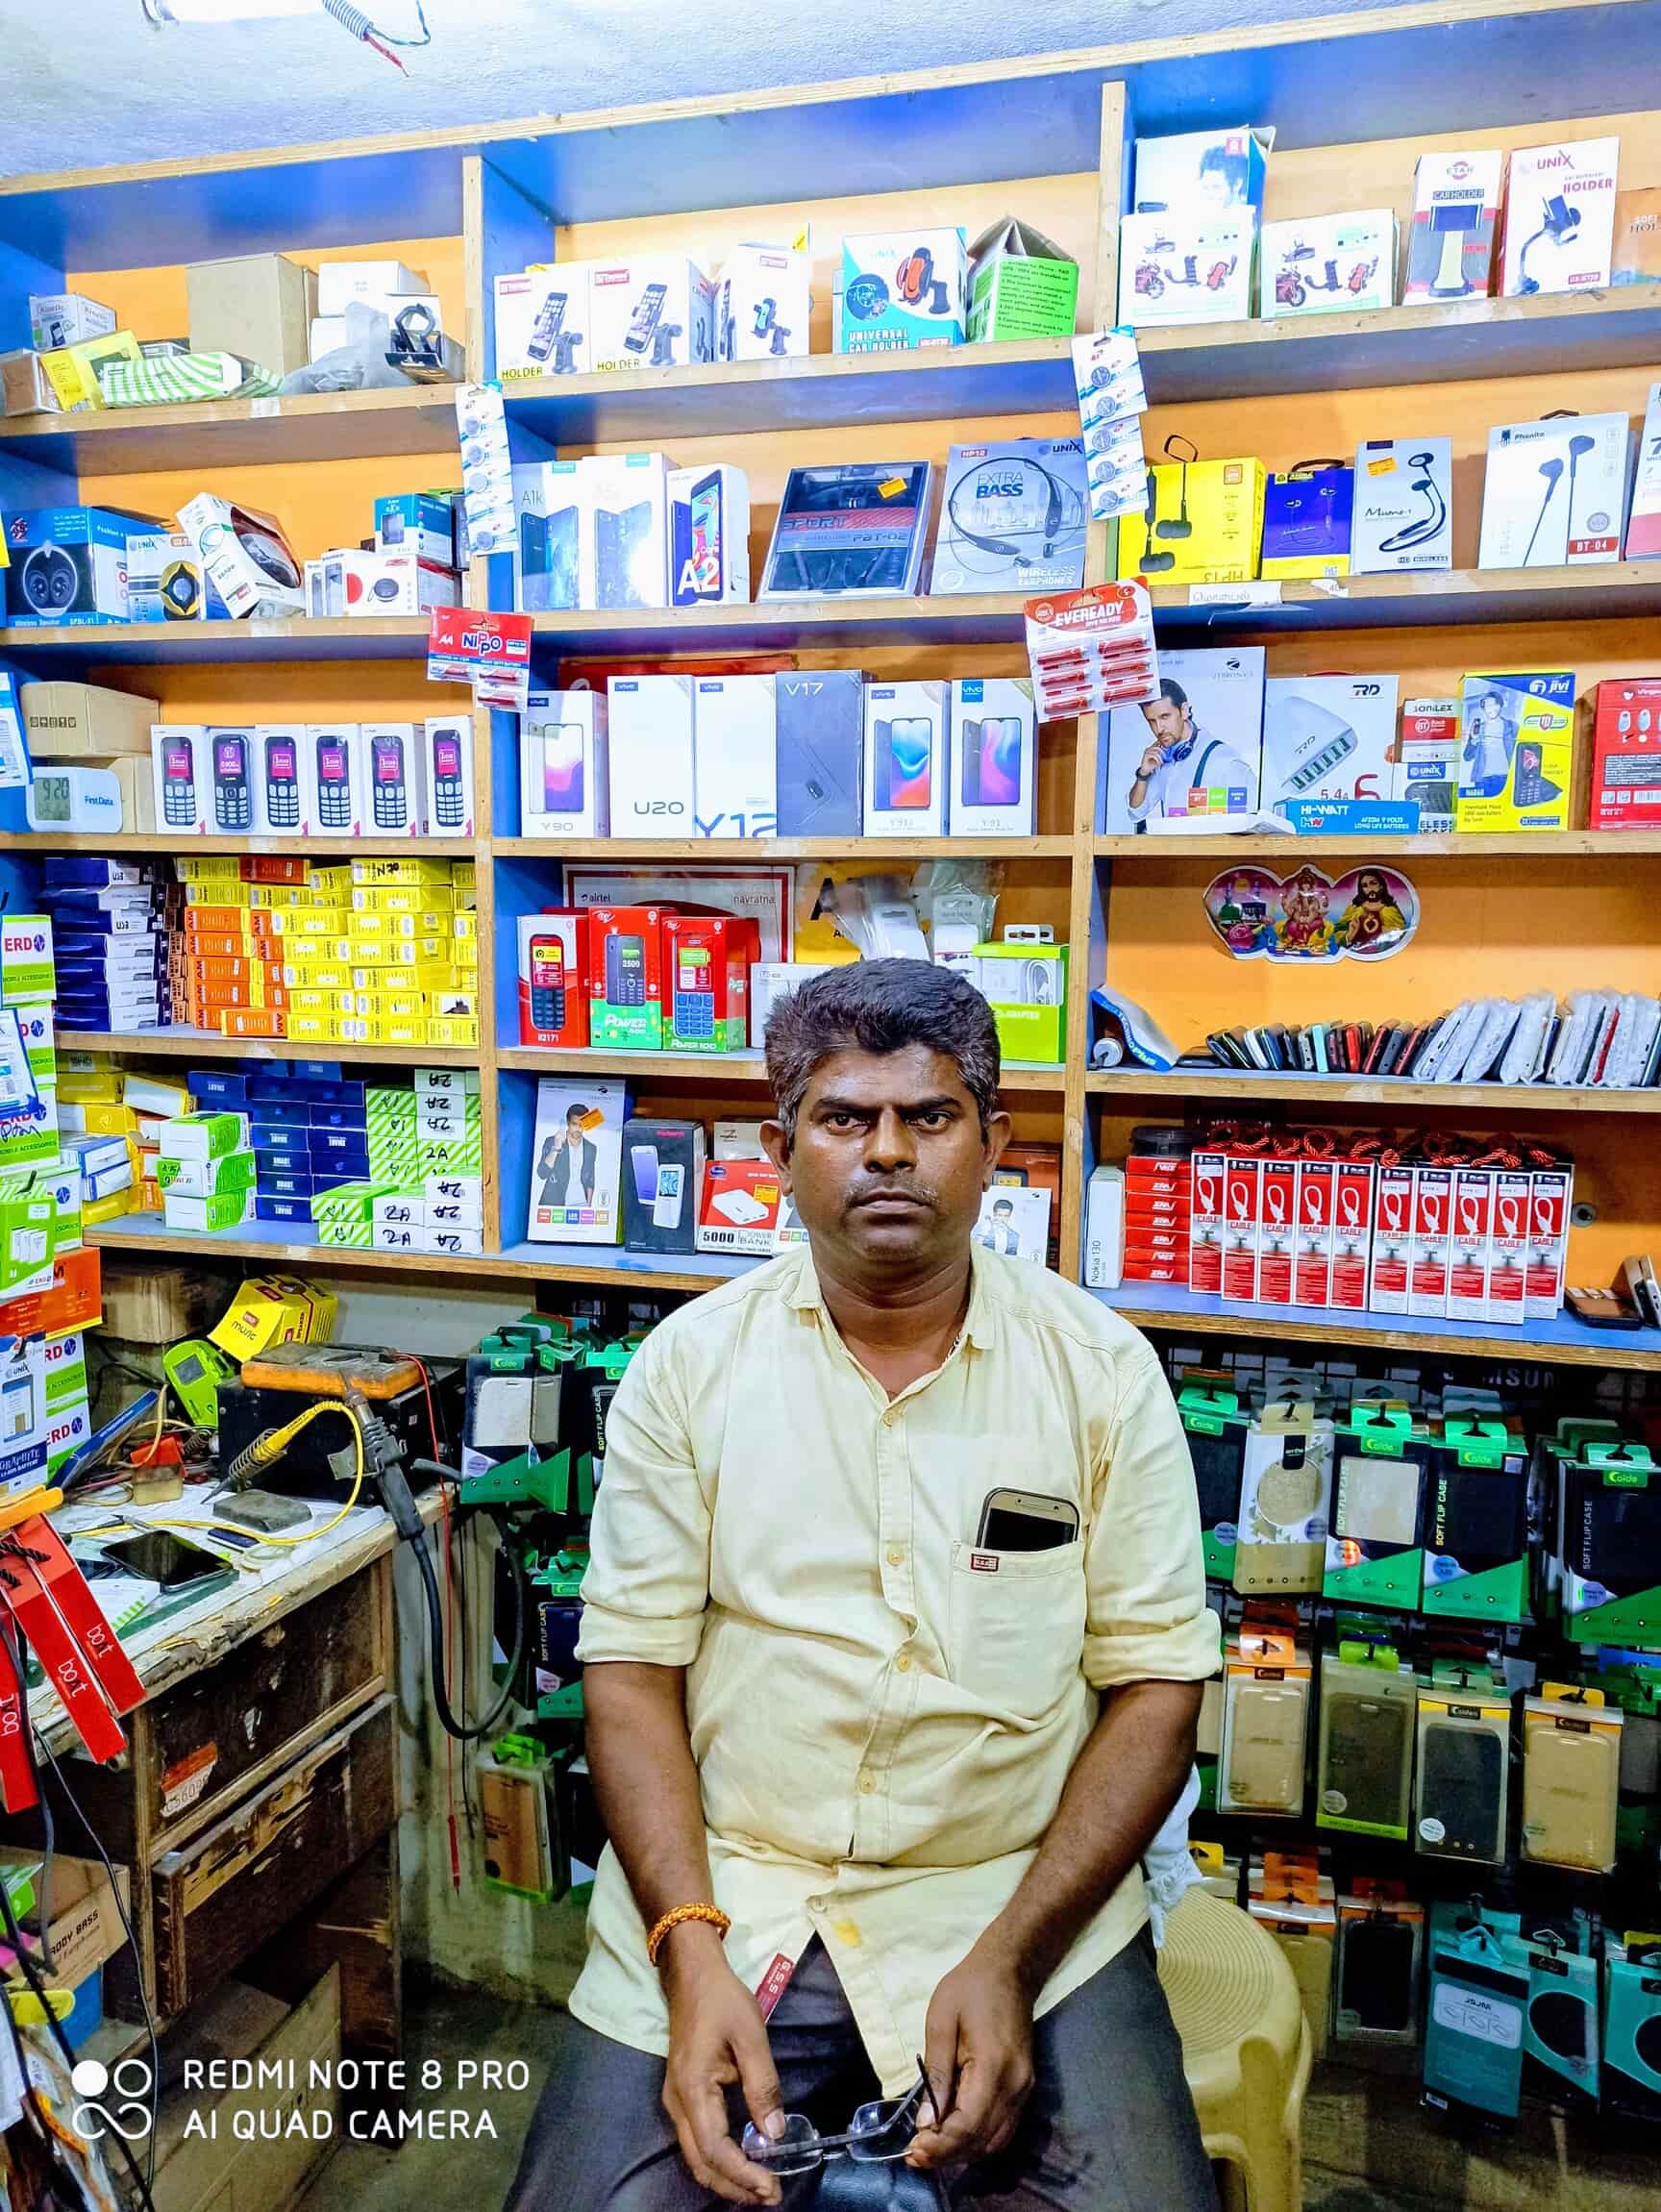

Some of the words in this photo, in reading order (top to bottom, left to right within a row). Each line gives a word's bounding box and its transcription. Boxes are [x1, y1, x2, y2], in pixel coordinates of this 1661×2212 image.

[1537, 150, 1574, 170] UNIX
[849, 327, 908, 342] UNIVERSAL
[597, 358, 641, 371] HOLDER
[501, 366, 544, 380] HOLDER
[1052, 439, 1083, 455] UNIX
[976, 471, 1025, 485] EXTRA
[976, 484, 1025, 500] BASS
[1575, 539, 1609, 554] BT-04
[1017, 564, 1077, 579] WIRELESS
[1054, 601, 1125, 627] EVEREADY
[438, 634, 454, 646] AA
[783, 681, 825, 697] V17
[1422, 763, 1442, 776] UNIX
[84, 795, 98, 805] First
[98, 795, 113, 806] Data
[632, 800, 685, 816] U20
[1300, 804, 1351, 816] HI-WATT
[540, 821, 574, 832] Y90
[589, 892, 611, 904] airtel
[732, 894, 777, 905] navratna
[4, 935, 33, 952] ERD
[426, 1147, 448, 1160] 2A
[385, 1205, 411, 1222] 2A
[1197, 1215, 1218, 1225] CABLE
[1229, 1222, 1252, 1231] CABLE
[1266, 1224, 1288, 1233] CABLE
[1303, 1225, 1325, 1234] CABLE
[1340, 1227, 1363, 1237] CABLE
[383, 1229, 412, 1247] 2A
[703, 1230, 735, 1244] 5000
[1457, 1236, 1482, 1247] CABLE
[1529, 1236, 1555, 1247] CABLE
[1497, 1239, 1523, 1250] CABLE
[230, 1319, 258, 1341] music
[45, 1345, 62, 1362] RD
[13, 1360, 30, 1375] UNIX
[1439, 1479, 1449, 1503] CASE
[1584, 1500, 1593, 1525] CASE
[1435, 1522, 1445, 1547] SOFT
[76, 1907, 100, 1936] BASS
